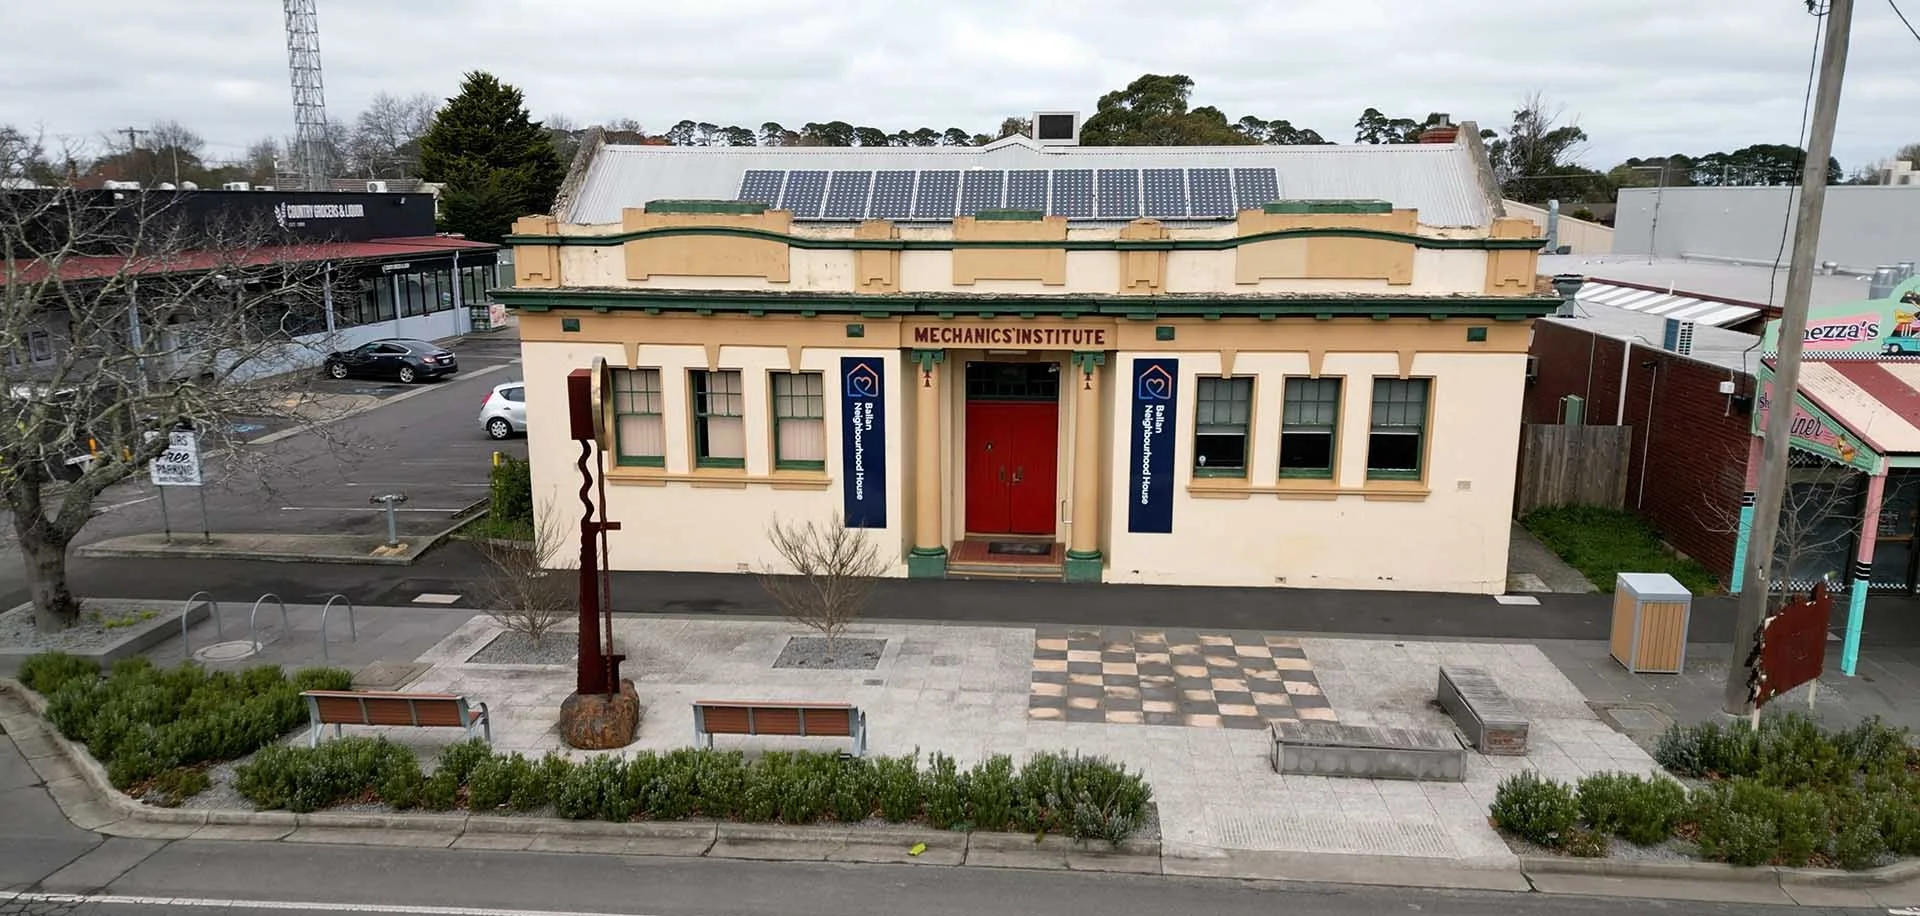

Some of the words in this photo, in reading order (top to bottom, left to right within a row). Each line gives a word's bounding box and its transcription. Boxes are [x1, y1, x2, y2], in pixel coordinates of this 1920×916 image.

[865, 402, 874, 431] Ballan
[1155, 404, 1165, 434] Ballan
[1791, 412, 1823, 436] iner
[852, 402, 864, 471] Neighbourhood
[1142, 404, 1153, 475] Neighbourhood
[856, 472, 864, 500] House
[1141, 476, 1151, 505] House
